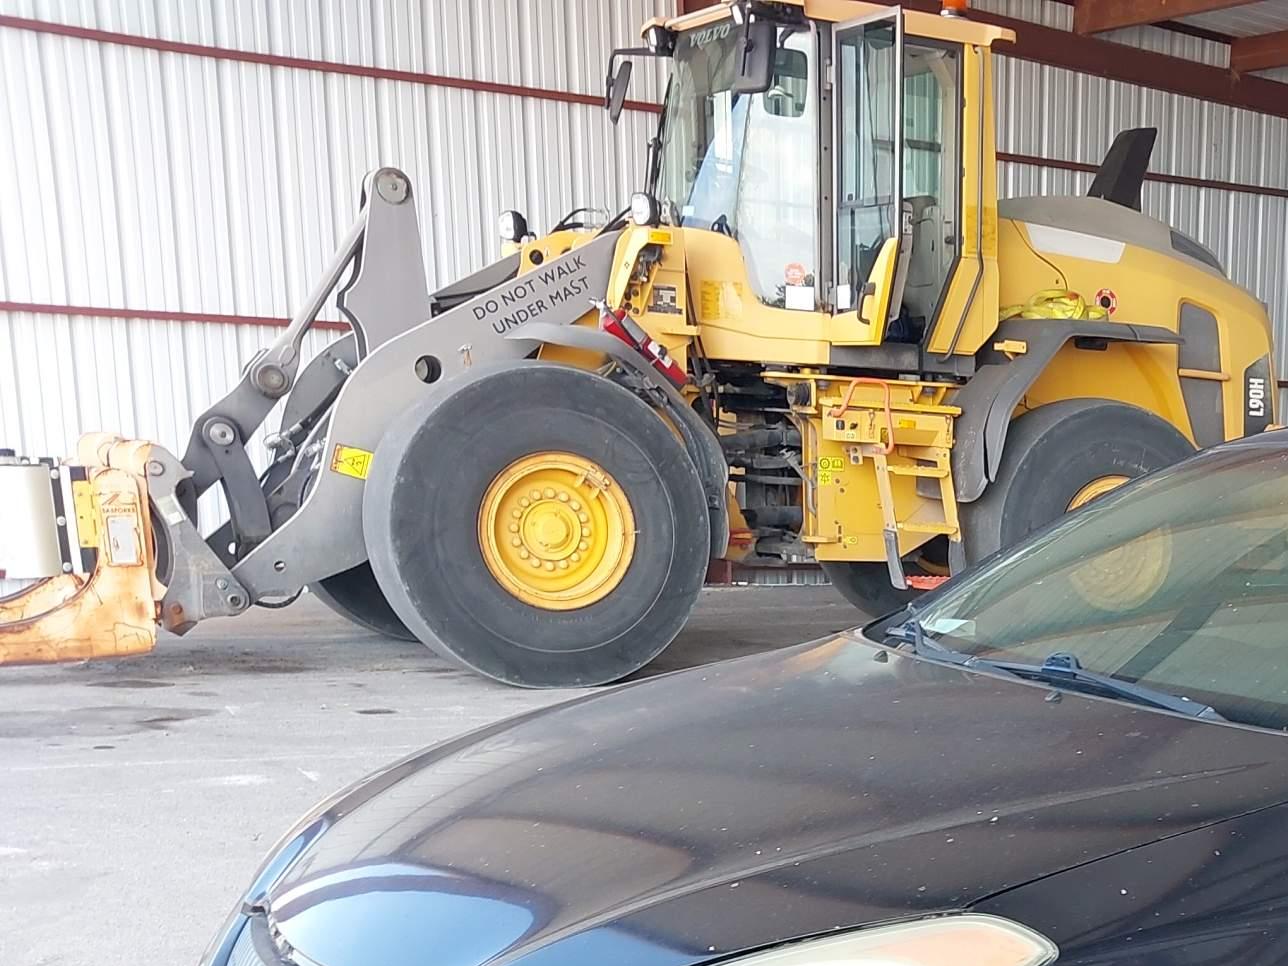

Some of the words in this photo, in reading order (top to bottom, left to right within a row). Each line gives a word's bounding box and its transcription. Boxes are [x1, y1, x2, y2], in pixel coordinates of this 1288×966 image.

[689, 23, 731, 49] VOLVO
[472, 300, 499, 320] DO
[501, 280, 536, 306] NOT
[538, 255, 587, 286] WALK
[492, 300, 548, 334] UNDER
[549, 276, 590, 307] MAST
[1248, 377, 1265, 417] L90H
